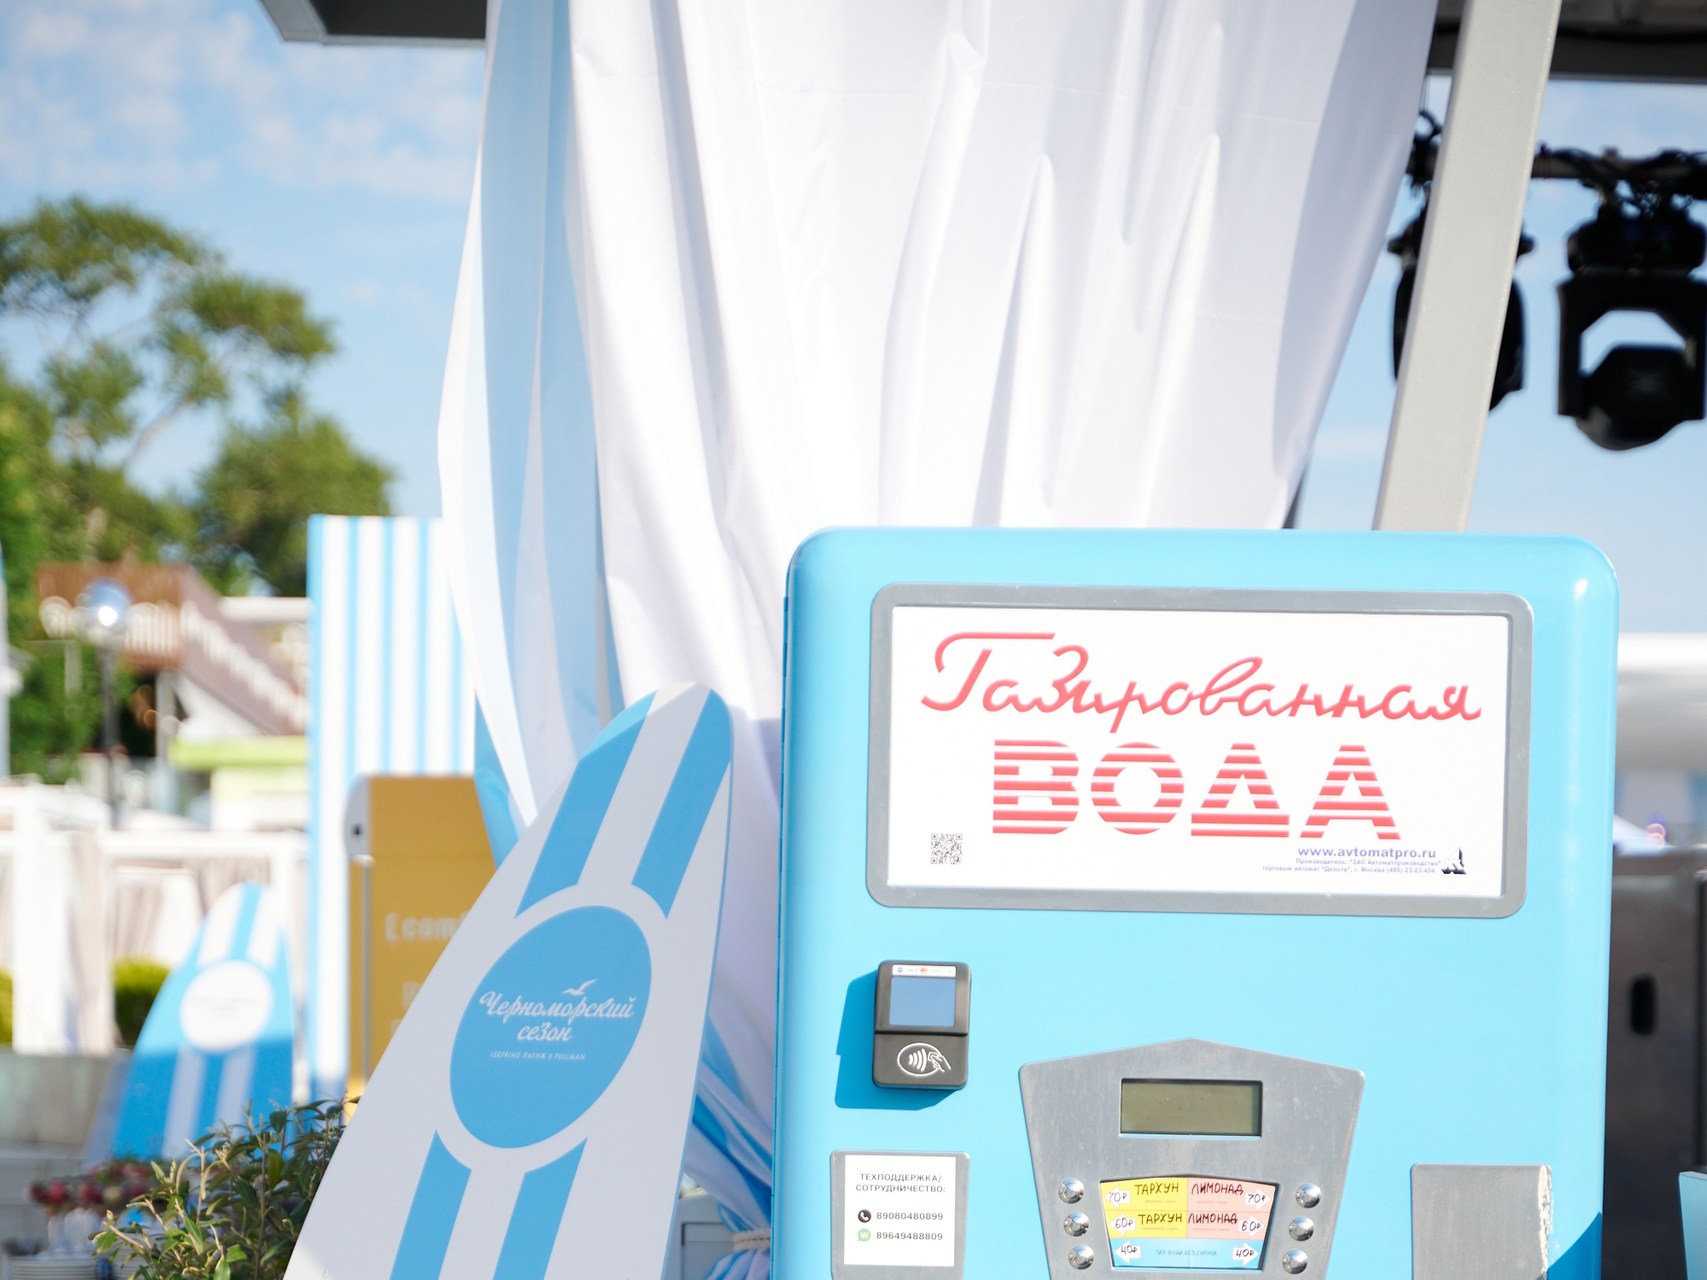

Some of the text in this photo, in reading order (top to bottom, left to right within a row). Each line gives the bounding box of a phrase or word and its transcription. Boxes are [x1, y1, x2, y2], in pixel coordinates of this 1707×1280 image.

[920, 631, 1483, 733] Газированная
[992, 739, 1401, 840] ВОДА
[1297, 847, 1437, 859] www.avtomatpro.ru
[479, 990, 638, 1025] Черноморский
[516, 1021, 574, 1042] сезон
[859, 1173, 943, 1183] ТЕХПОДДЕРЖКА/
[855, 1184, 946, 1193] СОТРУДНИЧЕСТВО:
[1134, 1182, 1180, 1196] ТАРХУН
[1191, 1183, 1244, 1196] ЛИМОНАД
[876, 1212, 944, 1220] 89080480899
[1138, 1213, 1183, 1225] ТАРХУН
[1188, 1213, 1238, 1225] ЛИМОНАД
[876, 1231, 944, 1240] 89649488809
